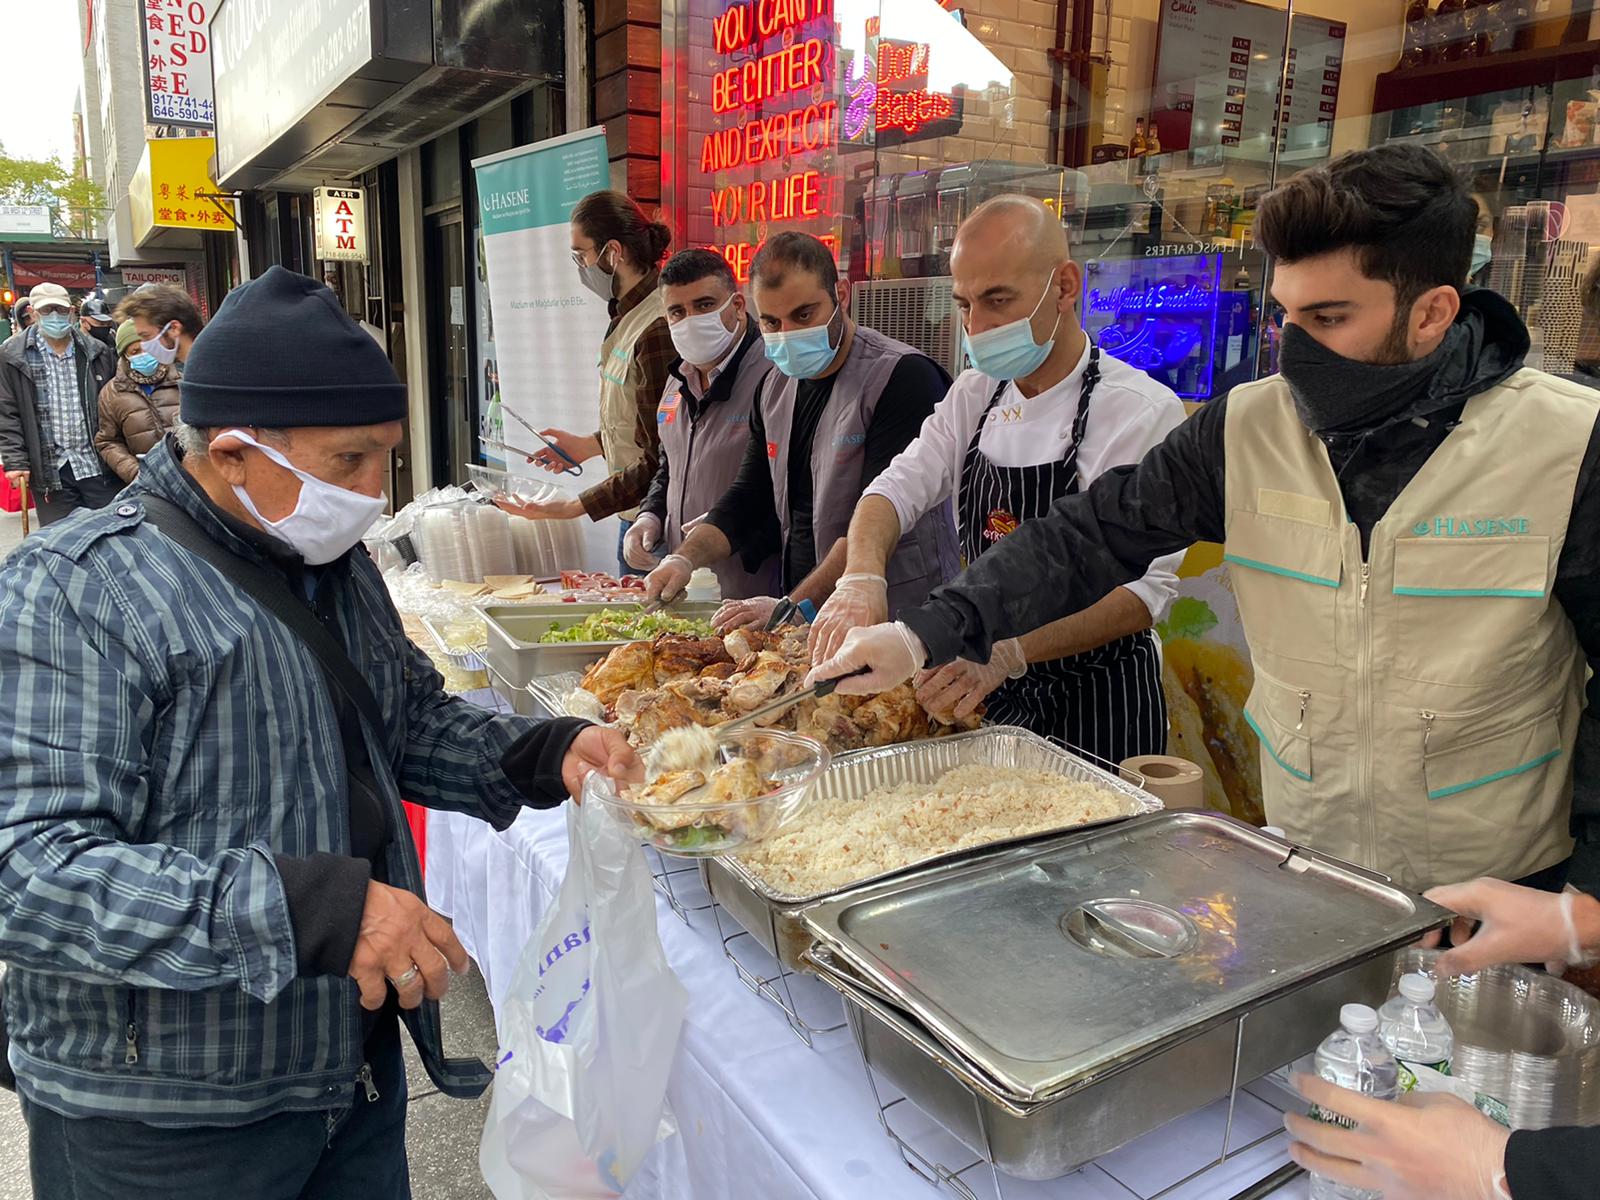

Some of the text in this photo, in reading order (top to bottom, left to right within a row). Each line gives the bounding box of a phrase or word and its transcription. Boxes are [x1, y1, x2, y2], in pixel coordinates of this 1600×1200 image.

[712, 2, 753, 54] YOU
[712, 67, 740, 113] BE
[701, 100, 837, 172] AND EXPECT
[490, 188, 531, 210] HASENE
[711, 171, 819, 227] YOUR LIFE
[334, 200, 356, 250] ATM
[125, 271, 180, 283] TAILORING
[1434, 516, 1530, 537] HASENE
